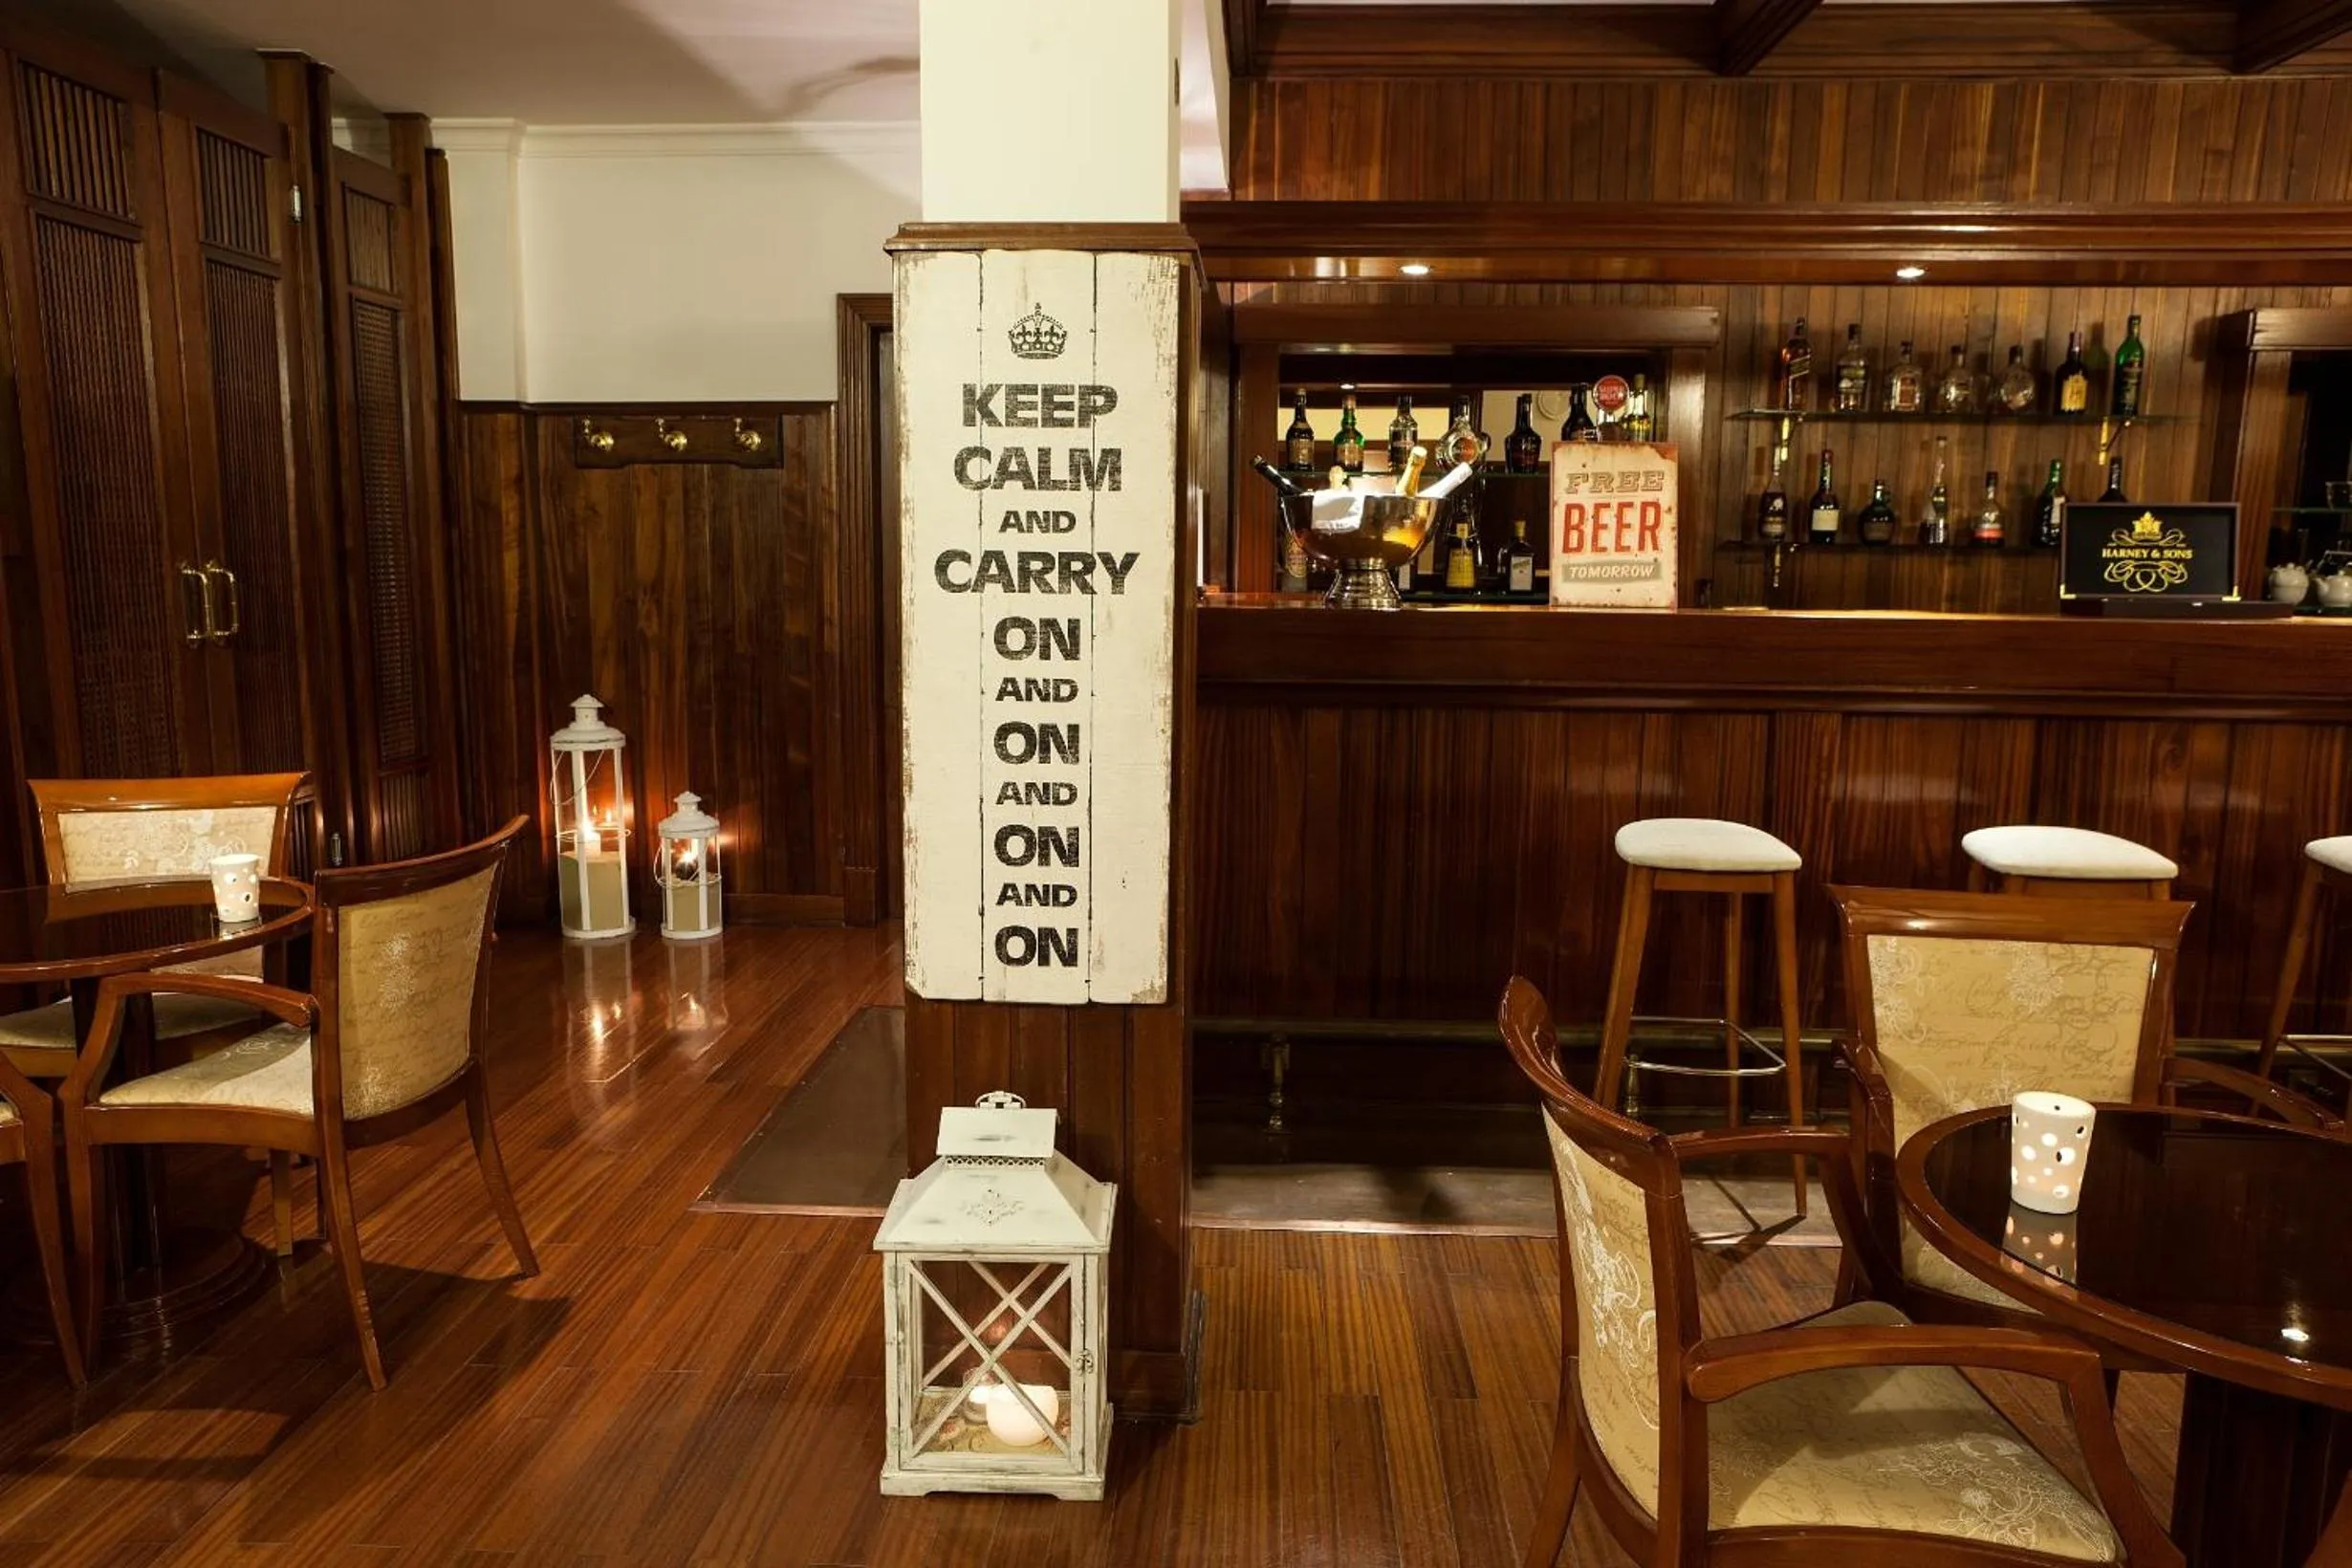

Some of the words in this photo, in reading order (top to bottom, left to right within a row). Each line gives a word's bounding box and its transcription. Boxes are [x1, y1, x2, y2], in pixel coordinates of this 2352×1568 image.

[964, 384, 1118, 427] KEEP
[954, 446, 1122, 491] CALM
[1566, 470, 1665, 494] FREE
[999, 511, 1076, 534] AND
[1562, 501, 1662, 554] BEER
[935, 550, 1140, 595] CARRY
[1569, 565, 1654, 578] TOMORROW
[2102, 549, 2148, 558] HARNEY
[2151, 549, 2160, 558] &
[2163, 550, 2192, 559] SONS
[994, 617, 1080, 661] ON
[996, 678, 1078, 703] AND
[994, 722, 1079, 764] ON
[996, 782, 1078, 806] AND
[994, 825, 1079, 867] ON
[996, 883, 1078, 907] AND
[995, 926, 1078, 967] ON
